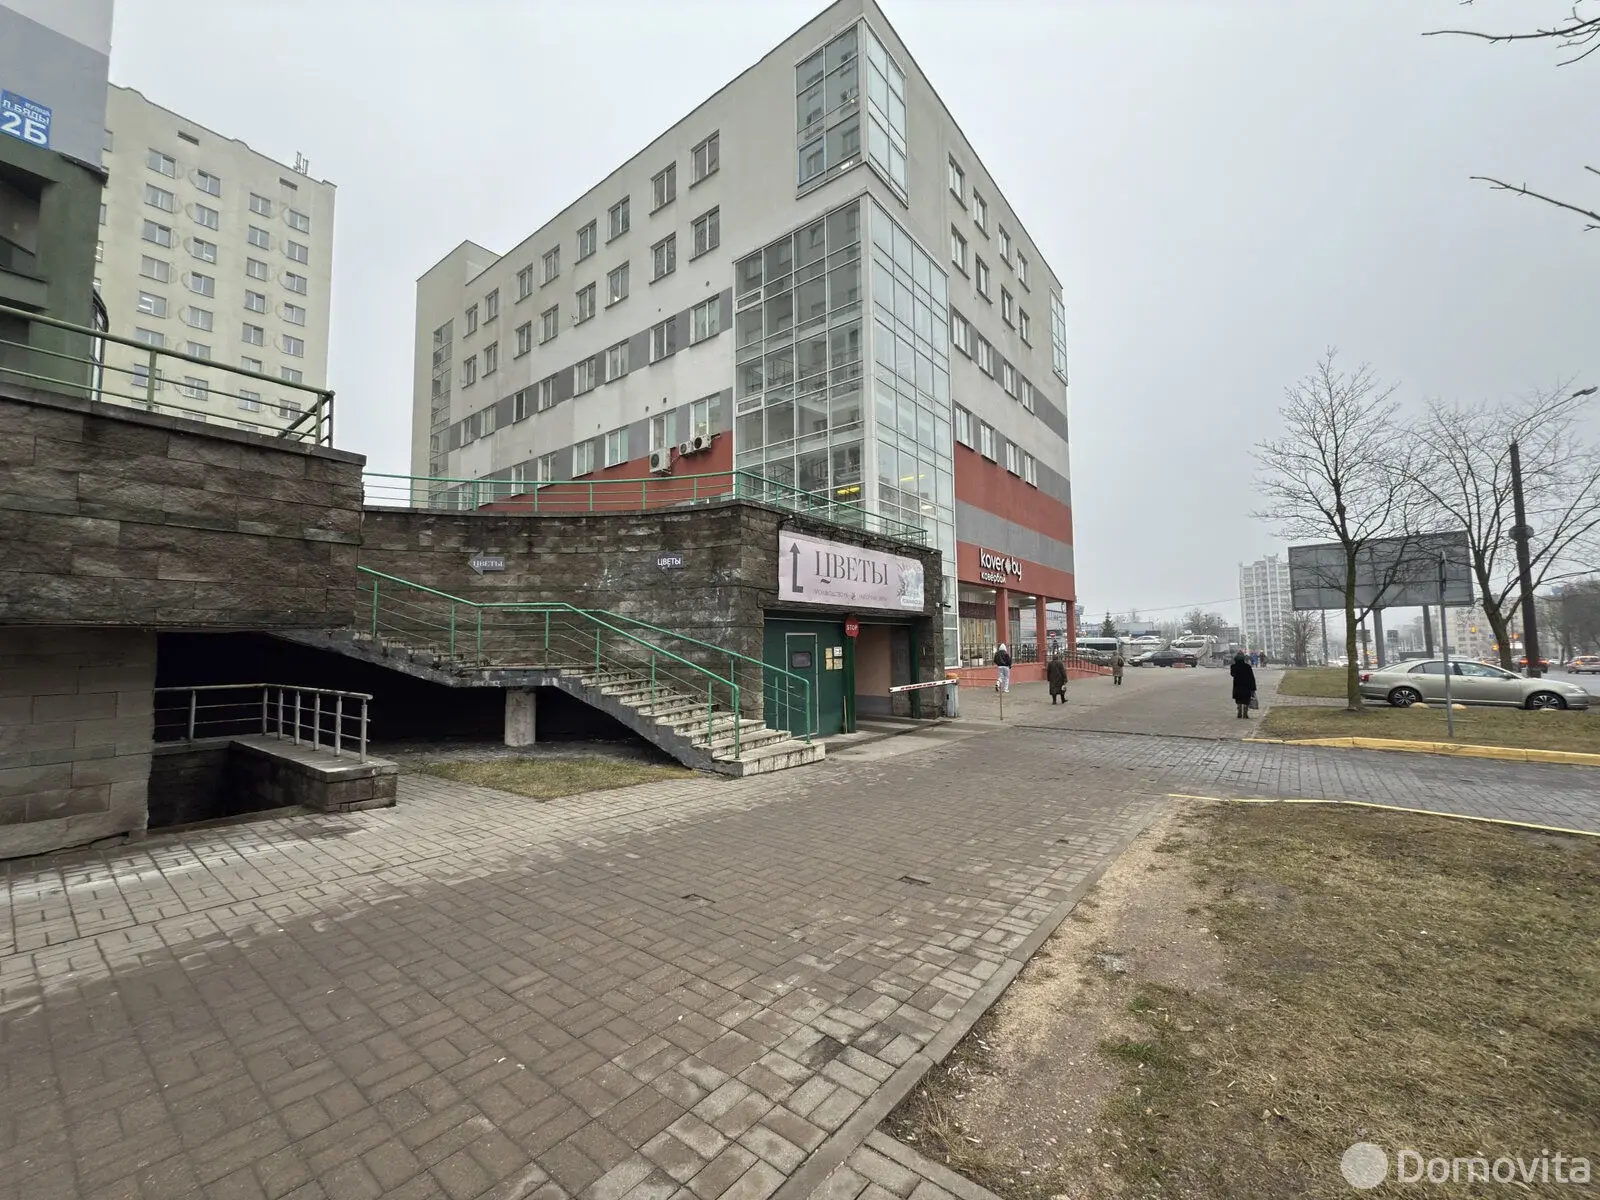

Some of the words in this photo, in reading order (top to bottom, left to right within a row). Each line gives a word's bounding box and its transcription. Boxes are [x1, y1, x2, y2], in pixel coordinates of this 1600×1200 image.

[0, 111, 47, 145] 2Б
[473, 560, 503, 568] ЦВЕТЫ
[657, 557, 681, 566] ЦВЕТЫ
[815, 551, 888, 585] ЦВЕТЫ
[980, 548, 1005, 571] kover
